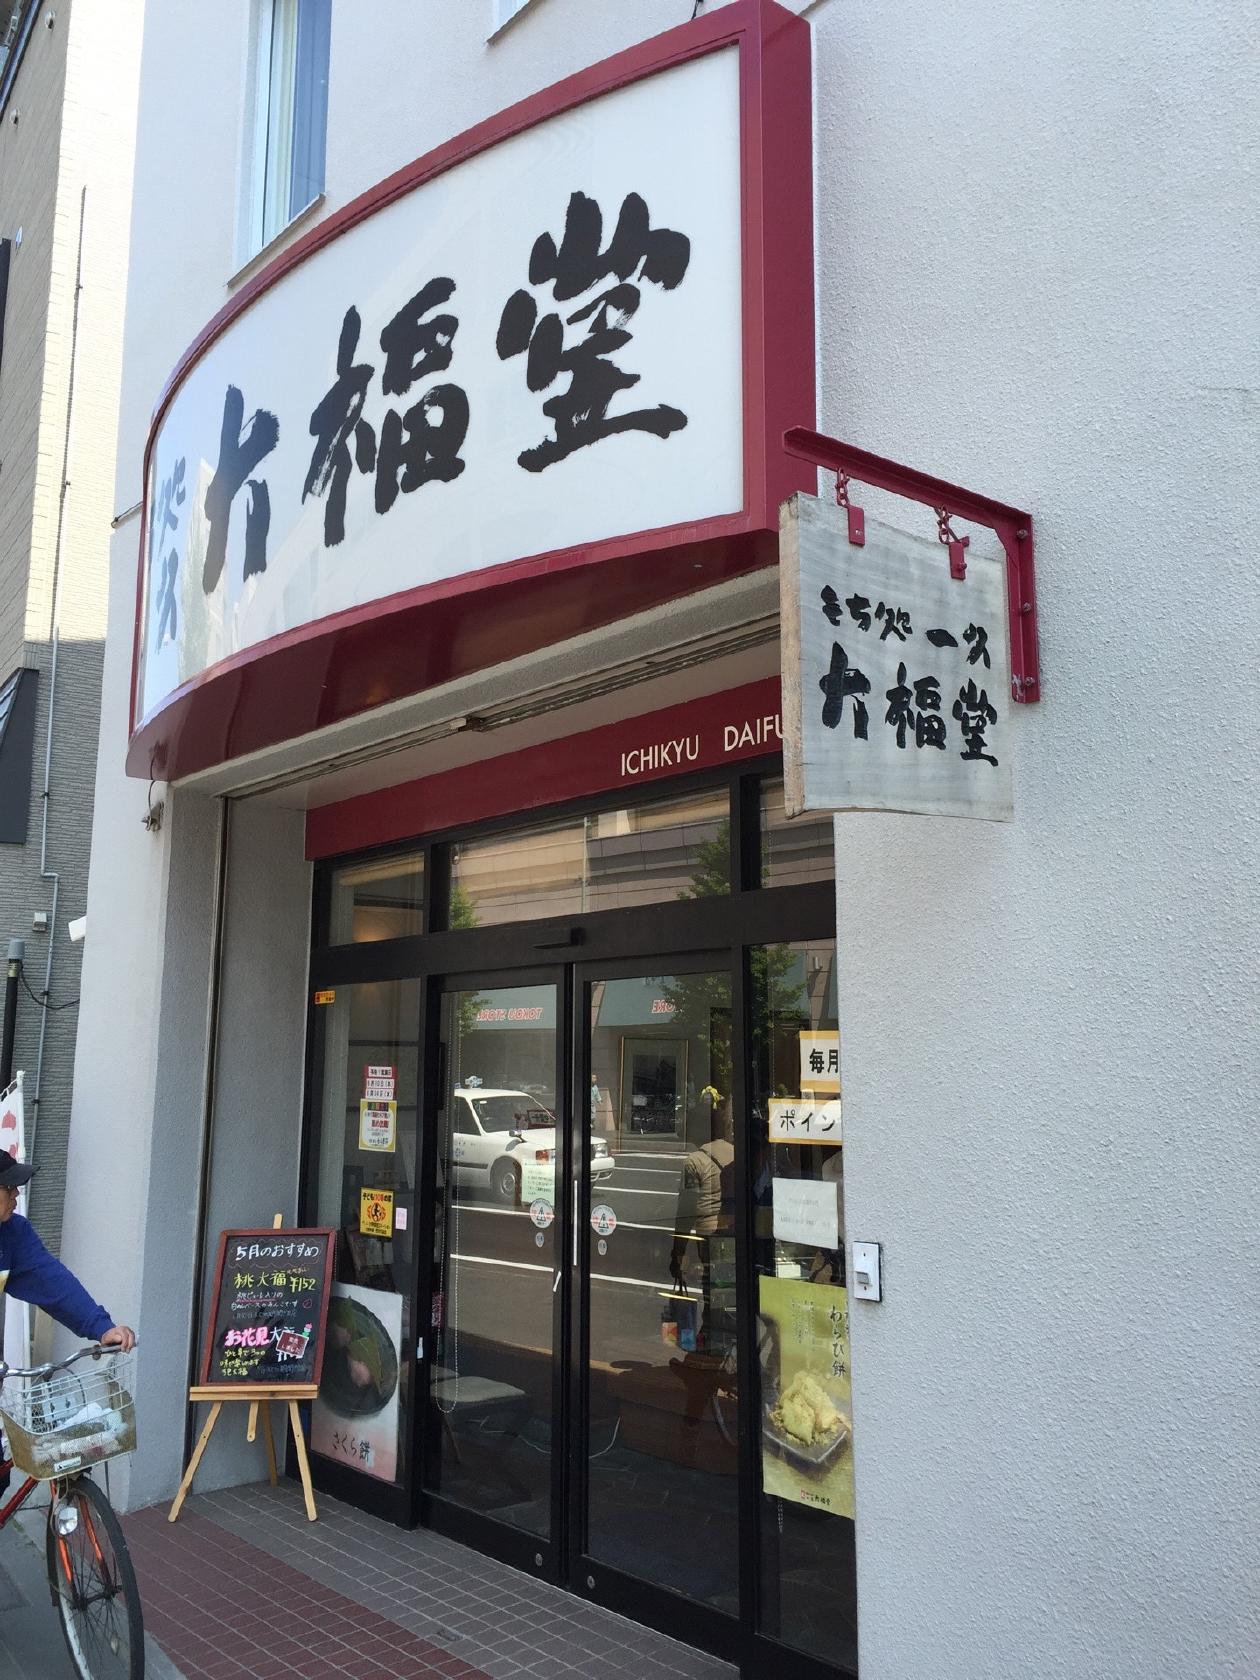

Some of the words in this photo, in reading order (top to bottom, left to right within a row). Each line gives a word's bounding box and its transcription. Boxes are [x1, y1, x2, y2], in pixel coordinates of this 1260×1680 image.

[203, 191, 690, 594] 大福堂
[819, 641, 998, 766] 大福堂
[621, 735, 699, 776] ICHIKYU
[809, 1048, 838, 1073] 毎月
[780, 1109, 836, 1132] ポイン
[235, 1243, 319, 1261] 5月のおすすめ
[233, 1270, 286, 1289] 桃大福
[224, 1326, 295, 1347] お花見大
[333, 1432, 370, 1462] さくら餅
